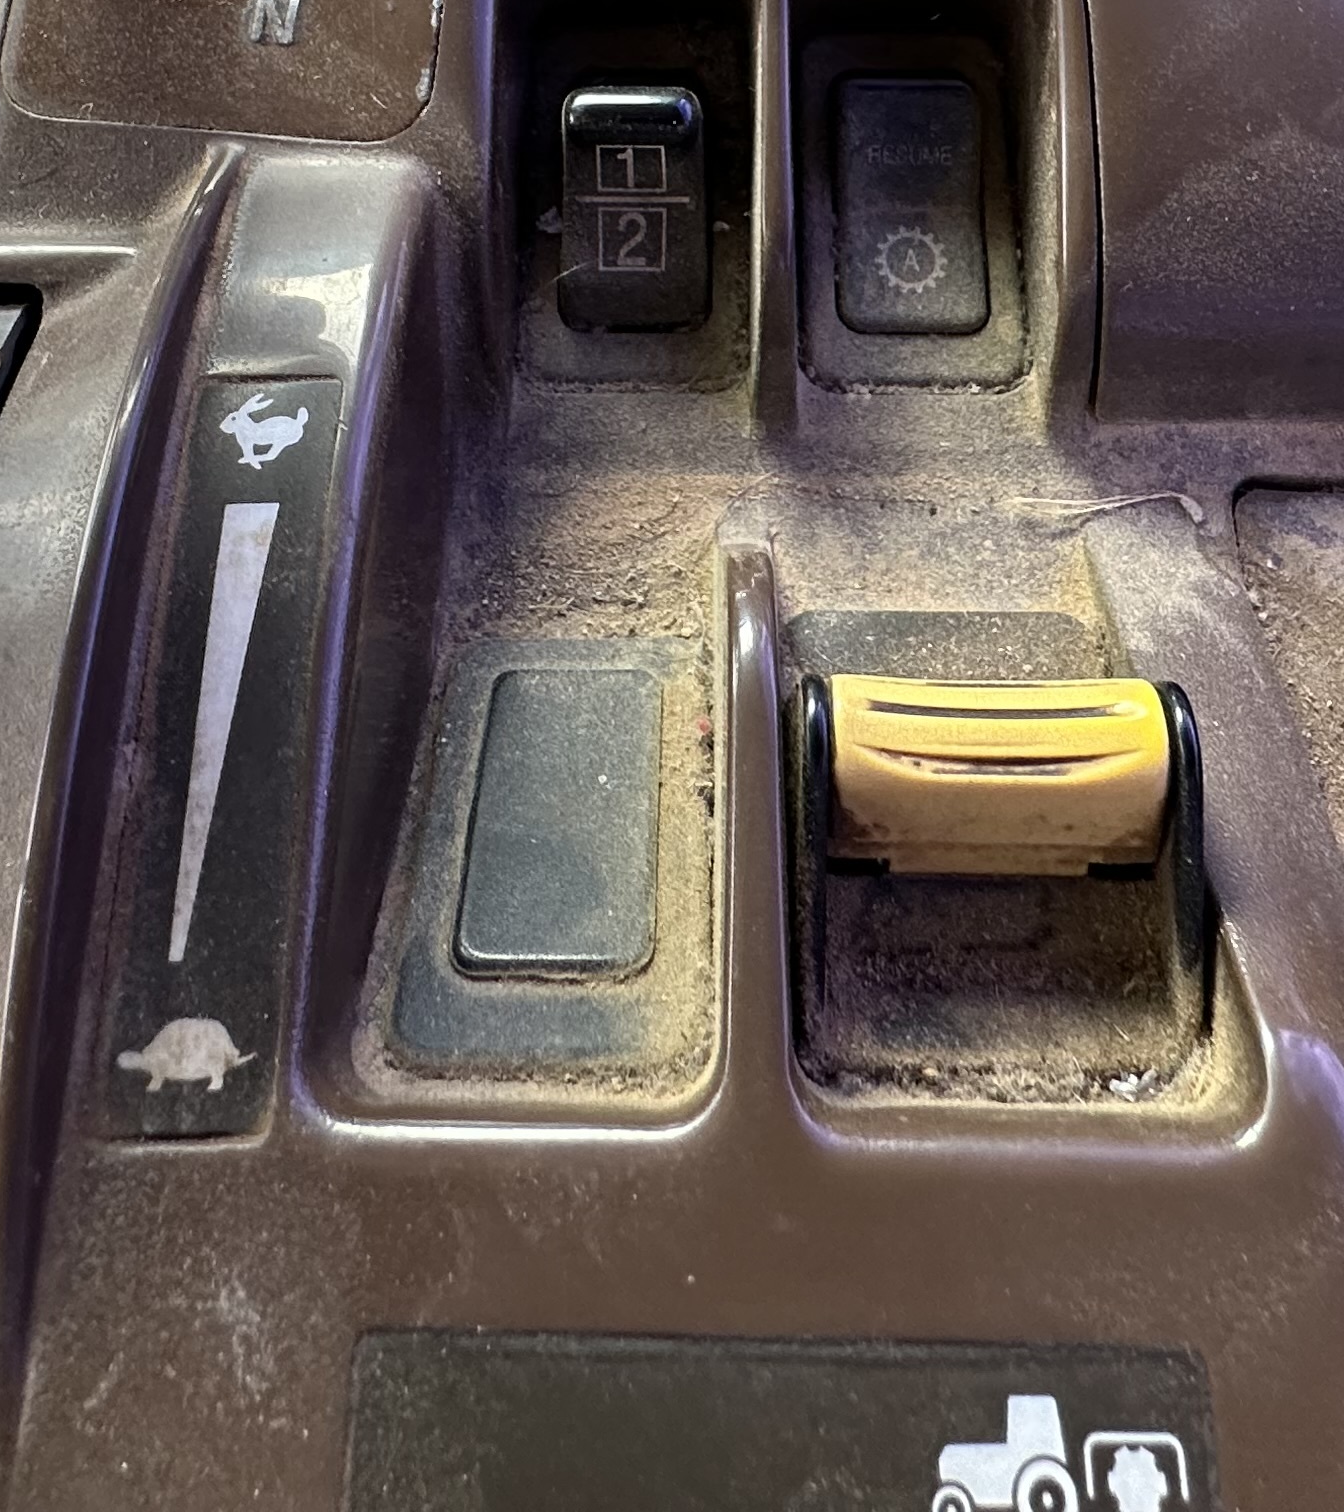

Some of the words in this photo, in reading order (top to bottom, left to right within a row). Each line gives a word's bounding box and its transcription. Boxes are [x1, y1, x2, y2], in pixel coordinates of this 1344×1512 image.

[617, 148, 636, 189] 1
[866, 144, 954, 166] RESUME
[616, 213, 647, 266] 2
